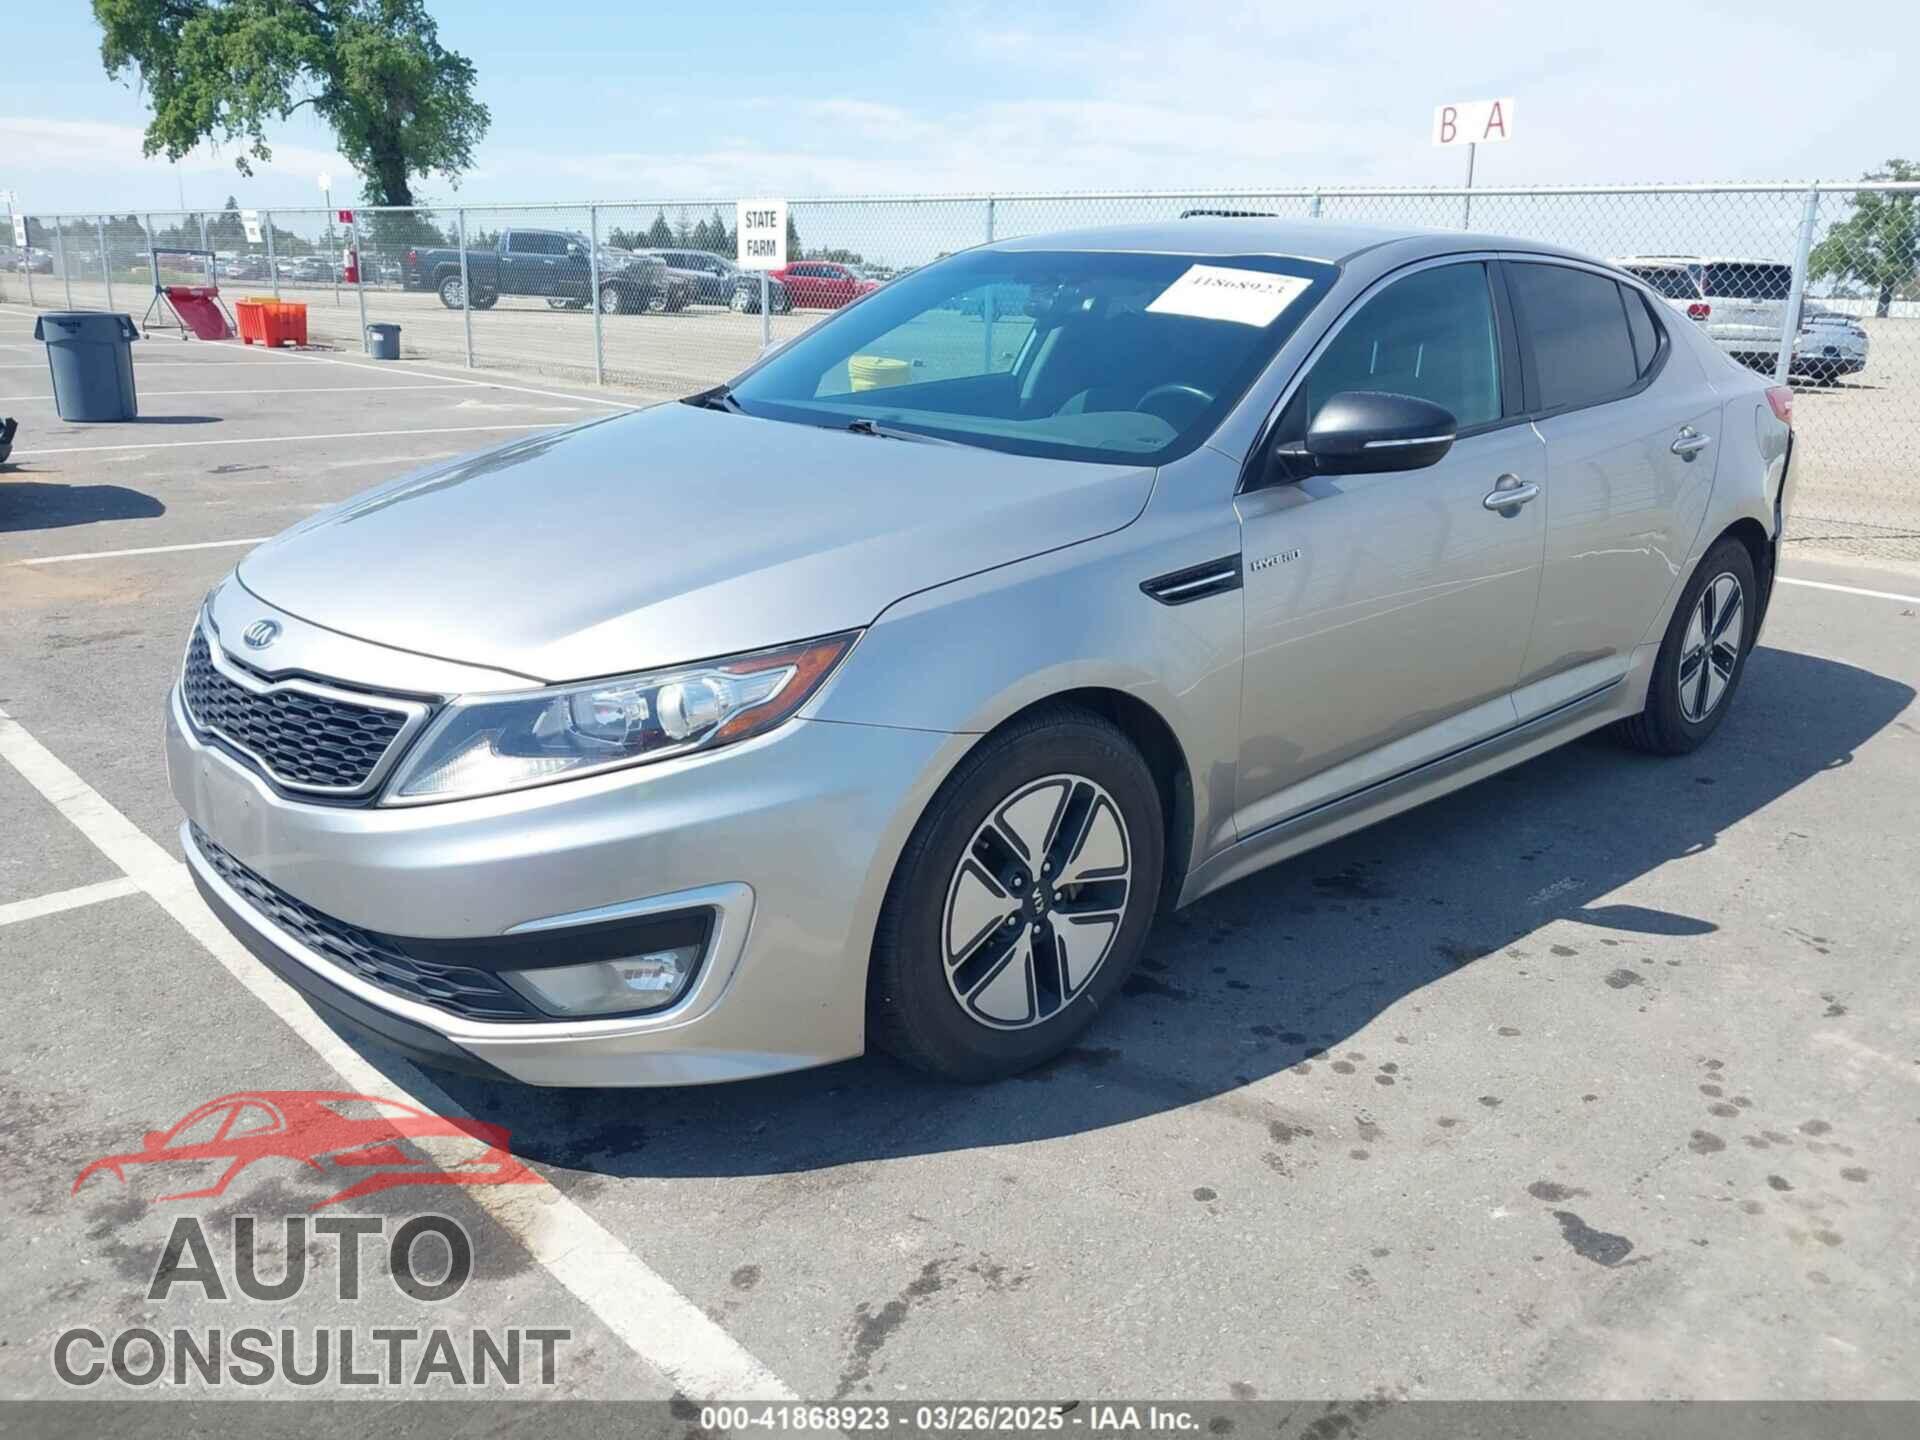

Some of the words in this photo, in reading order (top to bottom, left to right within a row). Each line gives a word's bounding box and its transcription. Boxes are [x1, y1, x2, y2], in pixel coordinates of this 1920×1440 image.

[1441, 106, 1457, 143] B
[1483, 100, 1505, 139] A
[745, 210, 777, 228] STATE
[747, 239, 777, 257] FARM
[1250, 548, 1301, 572] HYBRID
